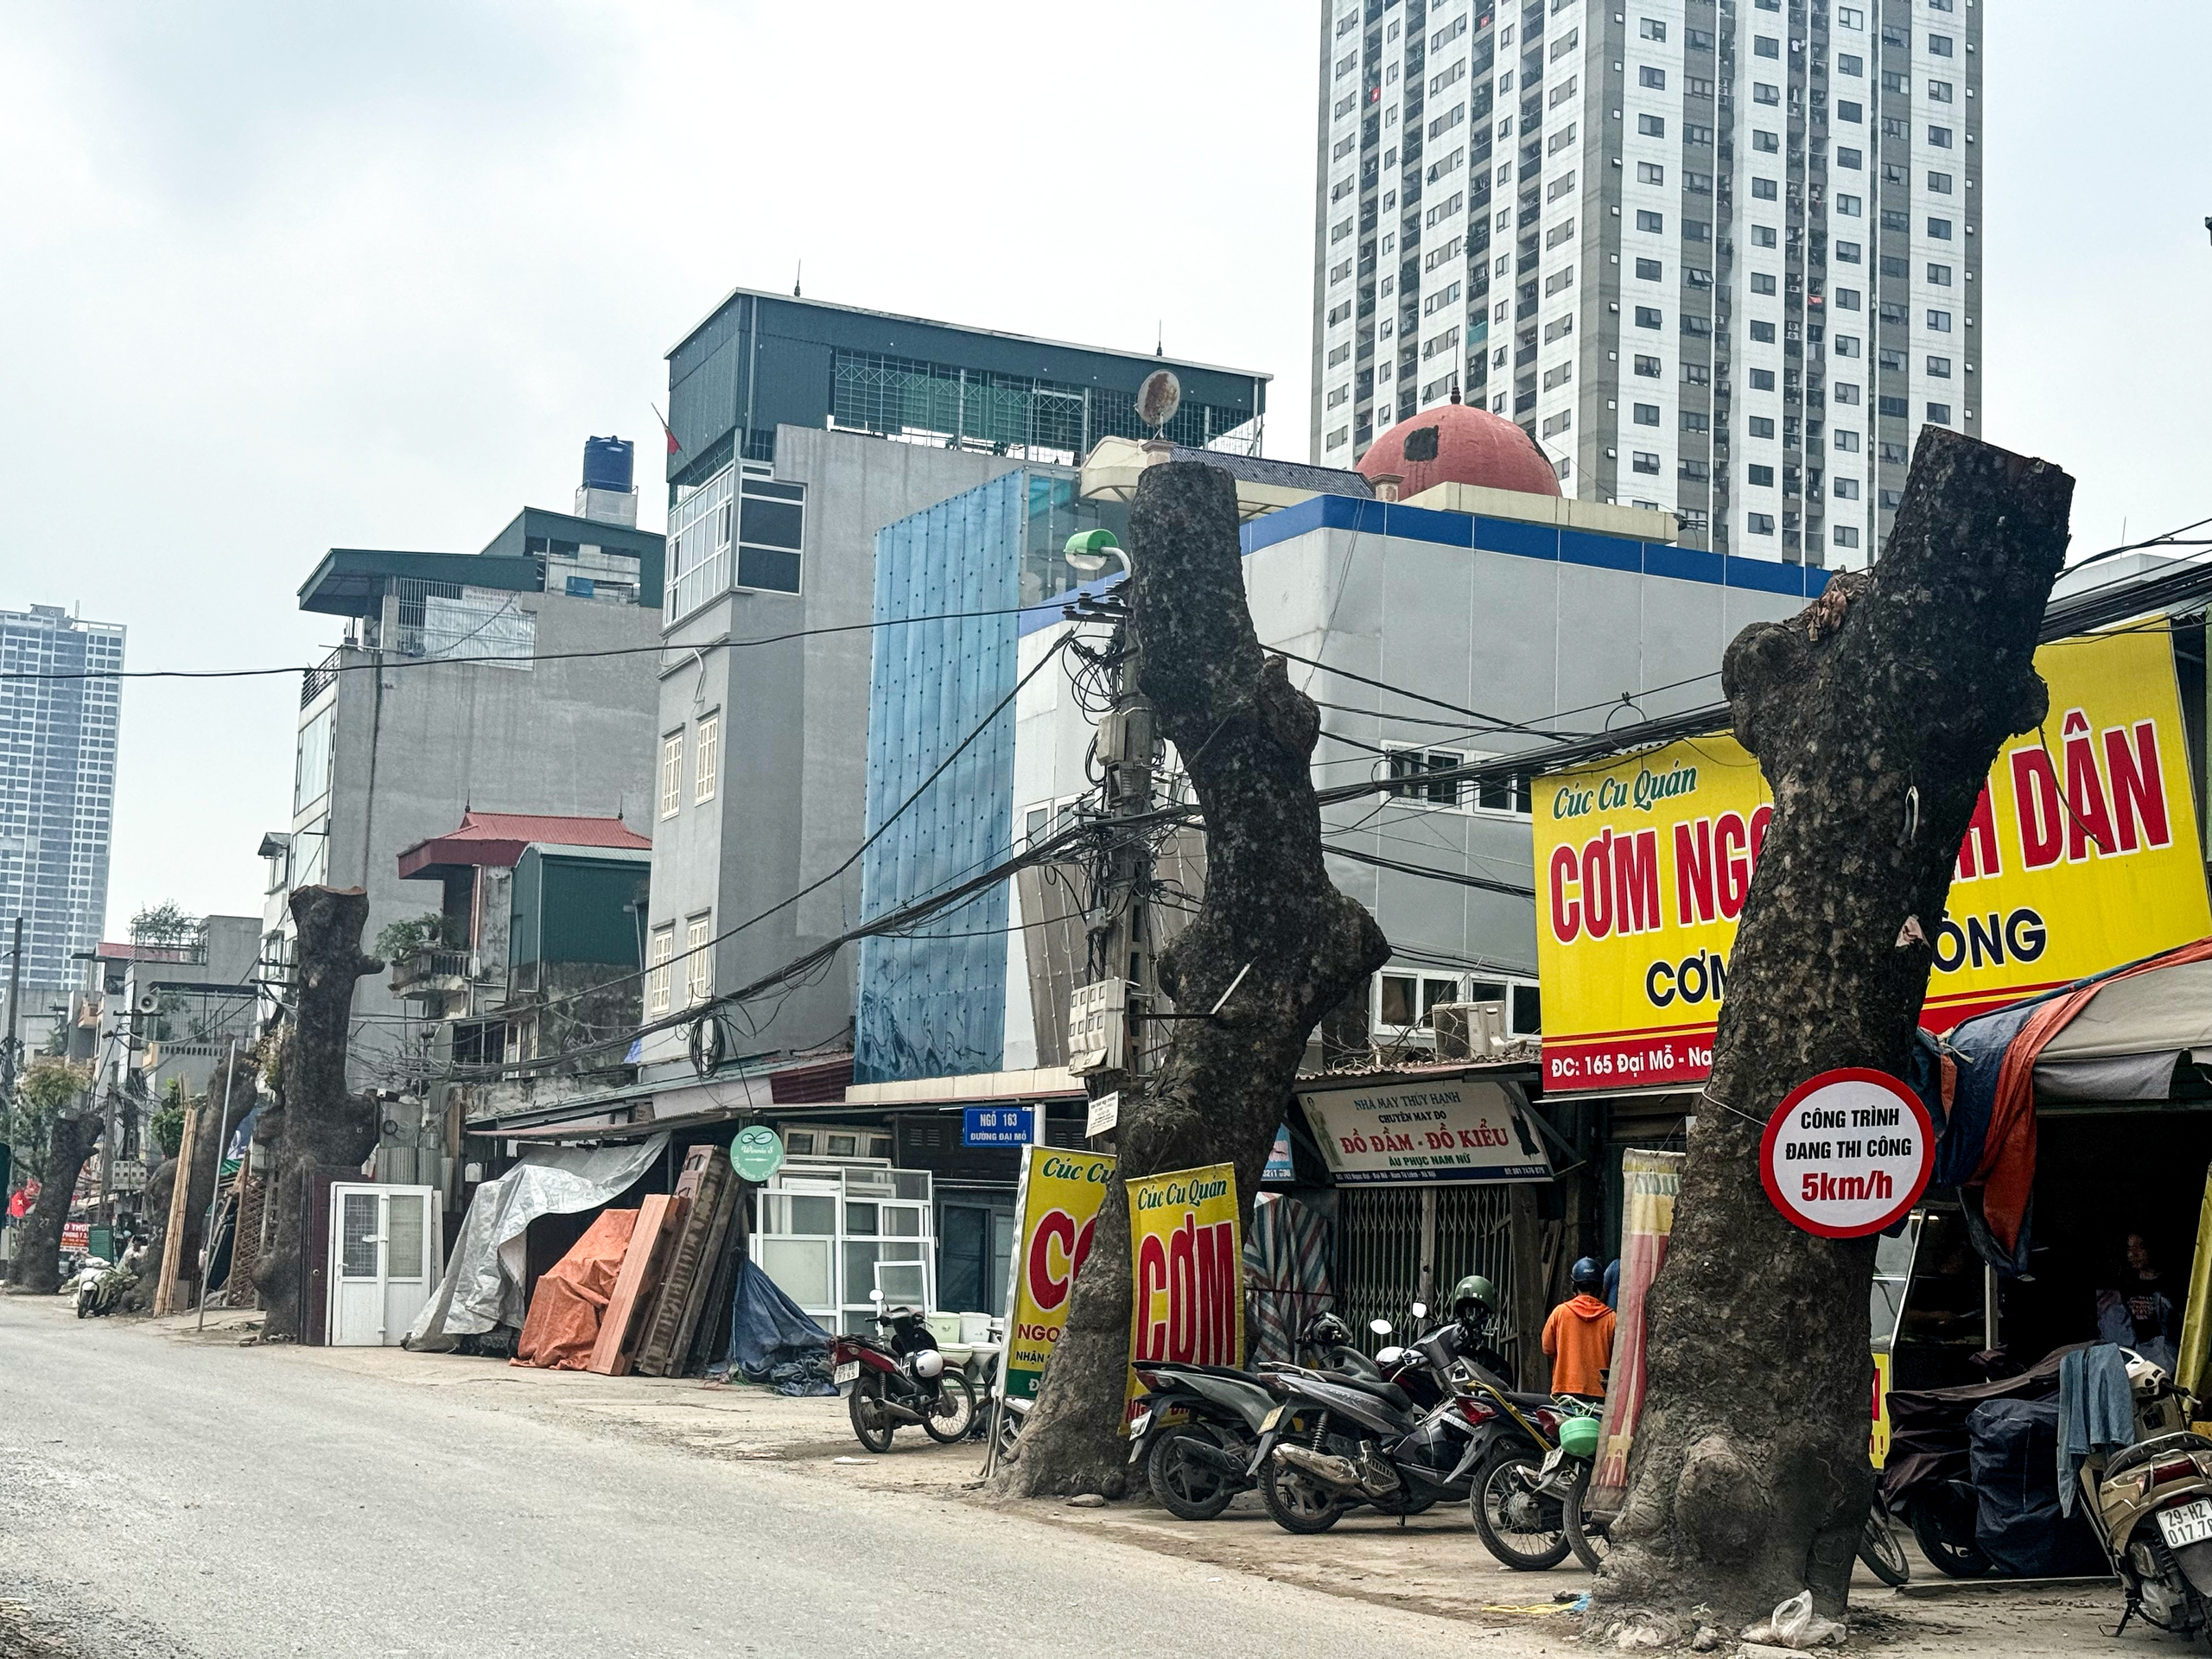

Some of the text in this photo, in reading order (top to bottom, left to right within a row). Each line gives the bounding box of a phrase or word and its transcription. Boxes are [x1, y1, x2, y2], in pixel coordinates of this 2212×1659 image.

[1554, 760, 1697, 819] Cúc Cu Quán
[1551, 829, 1661, 943] CƠM
[2011, 710, 2171, 869] DÂN
[1932, 908, 2046, 973] ÒNG
[1551, 1058, 1580, 1077] ĐC:
[1585, 1056, 1612, 1076] 165
[1617, 1052, 1644, 1077] Đại
[1649, 1045, 1675, 1071] Mỗ
[1688, 1047, 1713, 1067] Na
[1353, 1096, 1376, 1111] NHÀ
[1377, 1096, 1399, 1109] MAY
[1429, 1091, 1461, 1107] HẠNH
[1002, 1113, 1018, 1127] 163
[1413, 1110, 1432, 1122] MAY
[1801, 1105, 1899, 1129] CÔNG TRÌNH
[970, 1130, 997, 1141] ĐƯỜNG
[999, 1133, 1012, 1142] ĐẠI
[1339, 1128, 1368, 1154] ĐỒ
[1369, 1126, 1415, 1152] ĐẦM
[1424, 1122, 1455, 1150] ĐỒ
[1457, 1118, 1510, 1148] KIỂU
[1785, 1135, 1912, 1160] ĐANG THI CÔNG
[1042, 1157, 1084, 1181] Cúc
[1402, 1155, 1428, 1167] PHỤC
[1431, 1154, 1454, 1166] NAM
[1137, 1174, 1227, 1211] Cúc Cu Quán
[1802, 1170, 1892, 1202] 5km/h
[1135, 1213, 1236, 1366] CƠM
[1017, 1323, 1060, 1340] NGO
[1015, 1350, 1045, 1363] NHẬN
[2165, 1503, 2207, 1528] 29-H2
